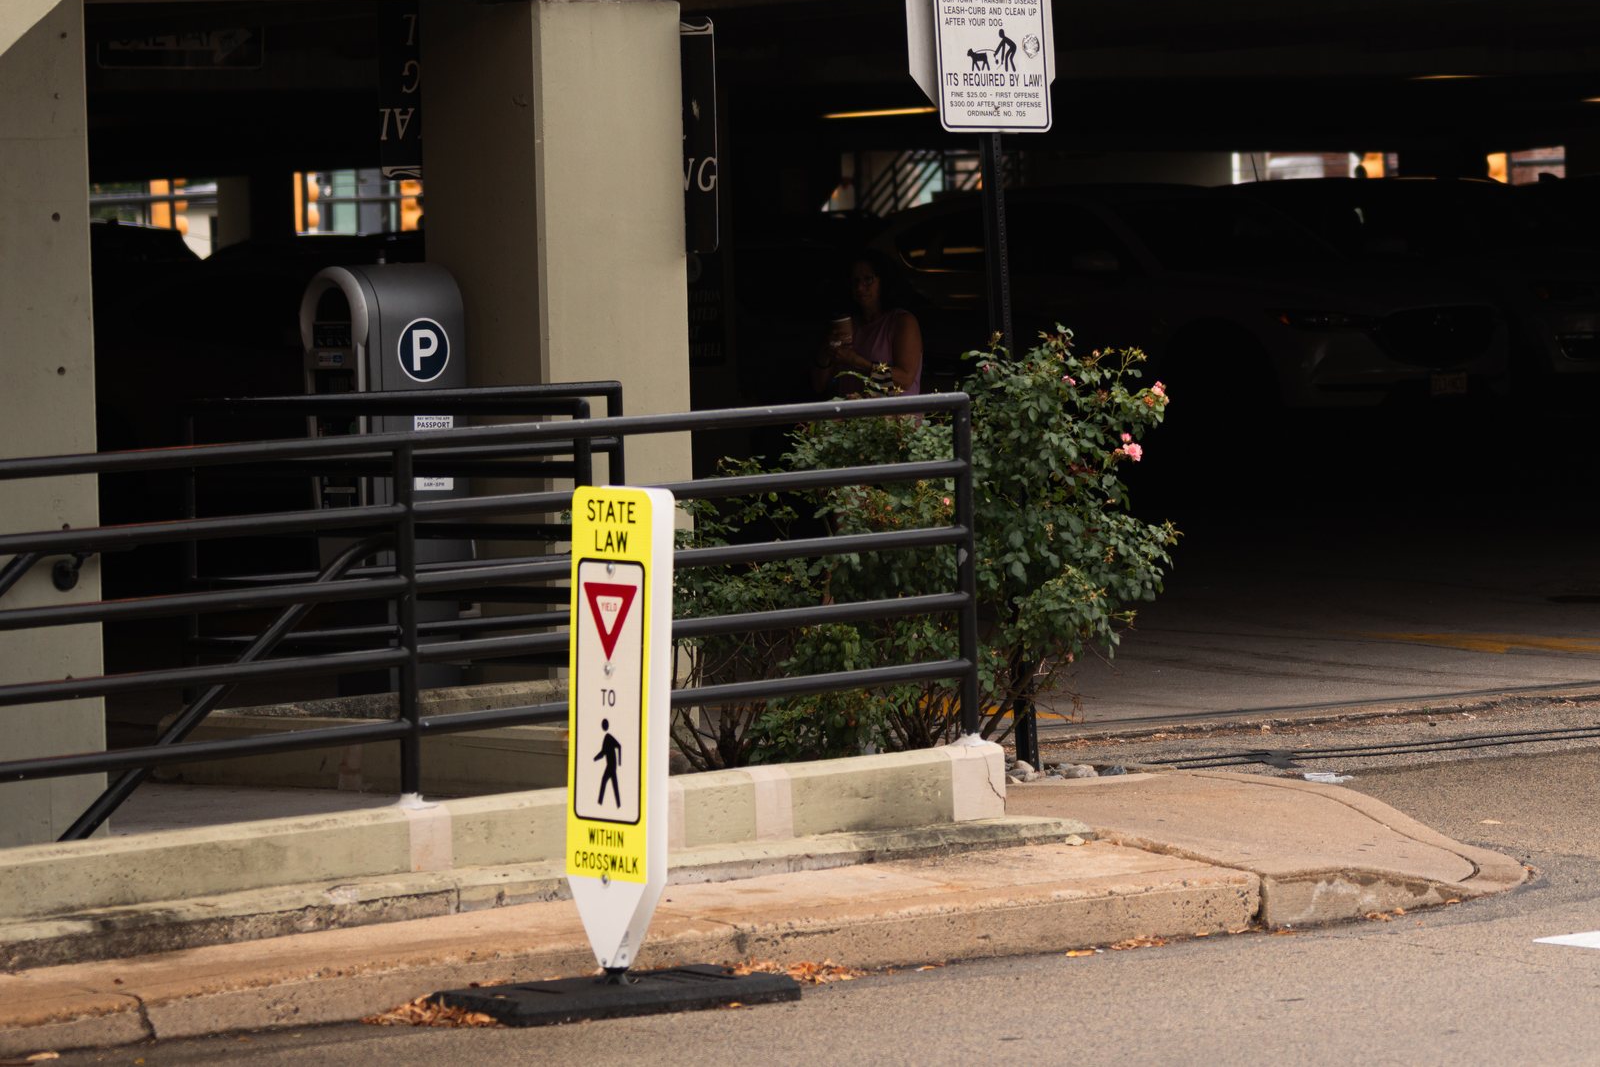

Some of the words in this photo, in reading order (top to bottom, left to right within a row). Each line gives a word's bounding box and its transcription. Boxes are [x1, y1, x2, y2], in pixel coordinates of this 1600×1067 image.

[944, 7, 986, 15] LEASH-CURB
[989, 7, 1002, 15] AND
[1005, 8, 1025, 16] CLEAN
[1028, 8, 1037, 16] UP
[945, 18, 966, 26] AFTER
[969, 18, 986, 26] YOUR
[989, 18, 1003, 27] DOG
[946, 73, 959, 86] ITS
[964, 73, 1005, 87] REQUIRED
[1010, 74, 1019, 87] BY
[1023, 75, 1043, 87] LAW!
[412, 329, 438, 371] P
[587, 500, 636, 524] STATE
[595, 530, 628, 552] LAW
[601, 602, 618, 612] YIELD
[601, 689, 616, 706] TO
[588, 828, 624, 848] WITHIN
[575, 850, 639, 874] CROSSWALK
